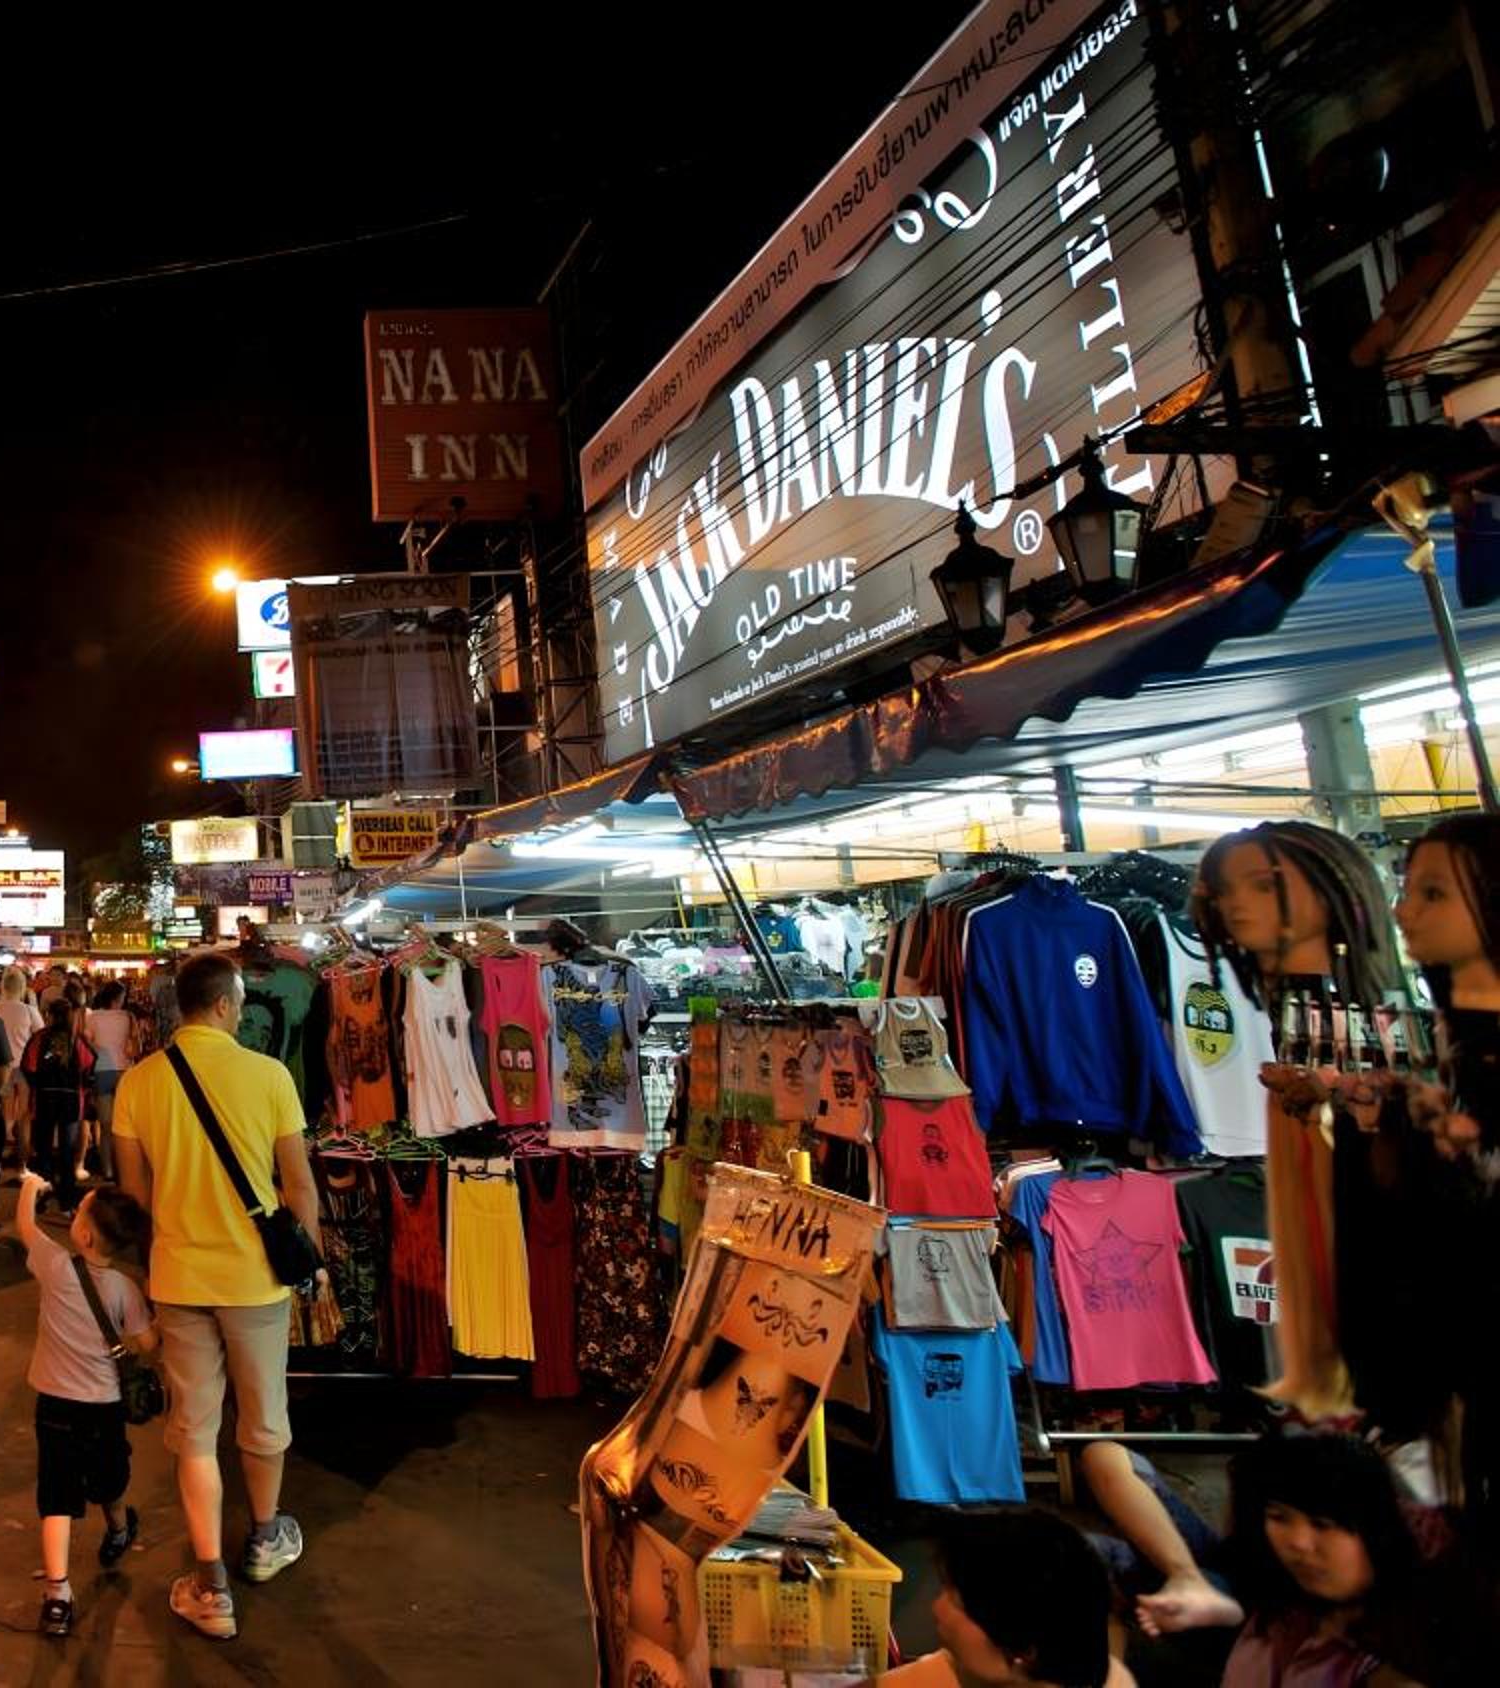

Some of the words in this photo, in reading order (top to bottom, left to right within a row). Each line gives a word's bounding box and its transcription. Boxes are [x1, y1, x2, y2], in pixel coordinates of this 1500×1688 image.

[405, 433, 531, 481] INN
[635, 448, 748, 696] JACK
[736, 584, 781, 645] OLD
[787, 557, 858, 600] TIME
[353, 816, 405, 833] OVERSEAS
[407, 815, 434, 832] CALL
[377, 835, 434, 853] INTERNET
[1235, 1281, 1278, 1301] ELEVE
